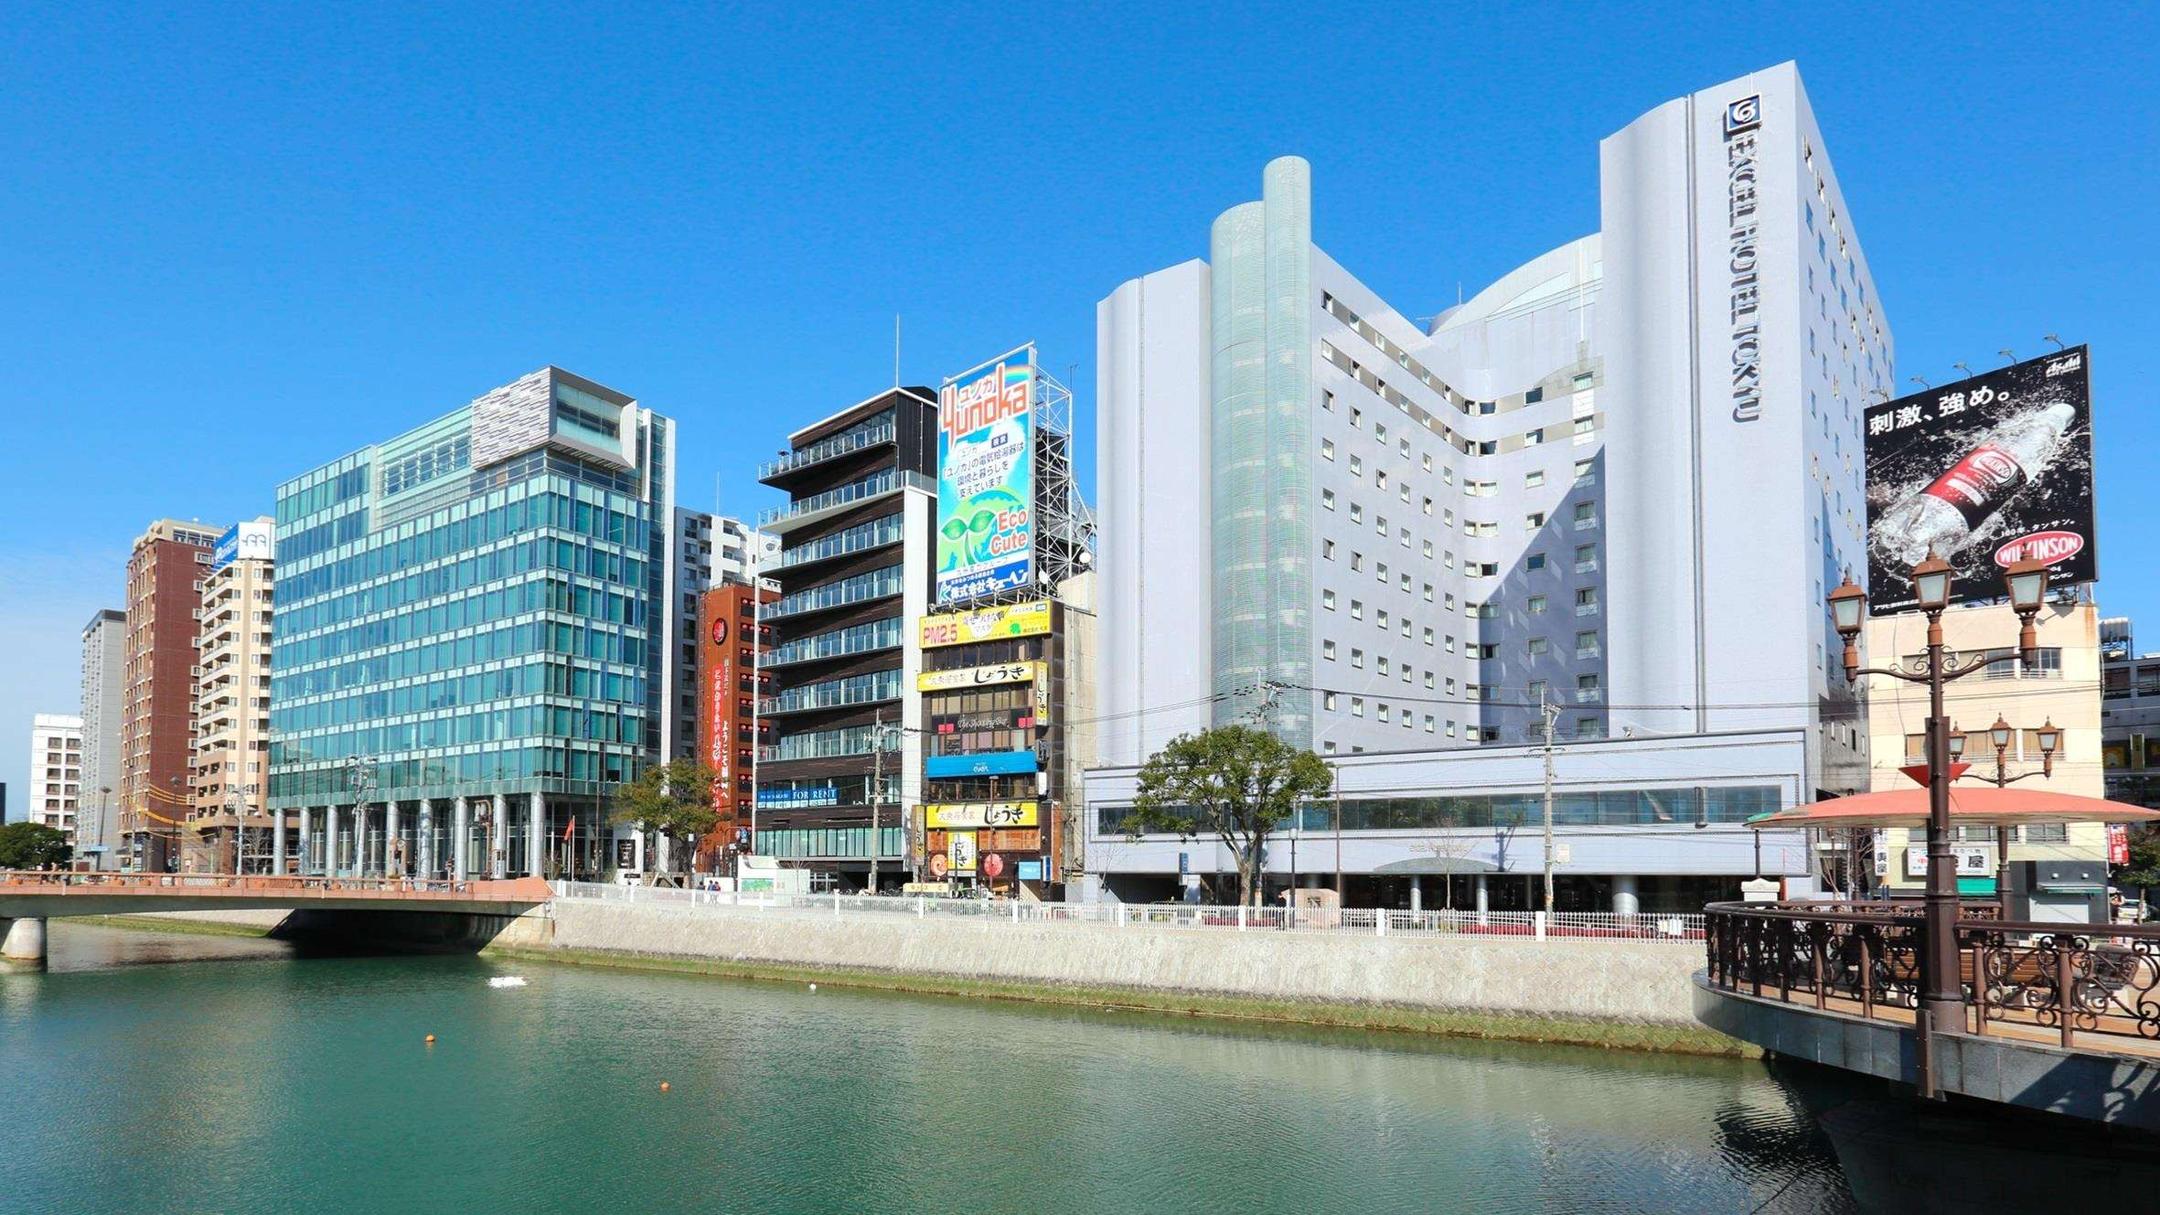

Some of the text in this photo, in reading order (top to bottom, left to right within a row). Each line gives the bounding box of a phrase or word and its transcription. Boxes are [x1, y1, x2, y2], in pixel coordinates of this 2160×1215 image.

[1730, 131, 1761, 423] EXCEL HOTEL TOKYU
[943, 365, 1027, 447] Yunoka
[1870, 385, 2009, 435] 刺激、強め。
[998, 511, 1027, 531] Eco
[991, 533, 1027, 554] Cute
[923, 623, 958, 645] PM2.5
[974, 665, 1025, 684] しょうき
[792, 791, 809, 800] FOR
[813, 789, 836, 799] RENT
[984, 804, 1023, 824] しょうき
